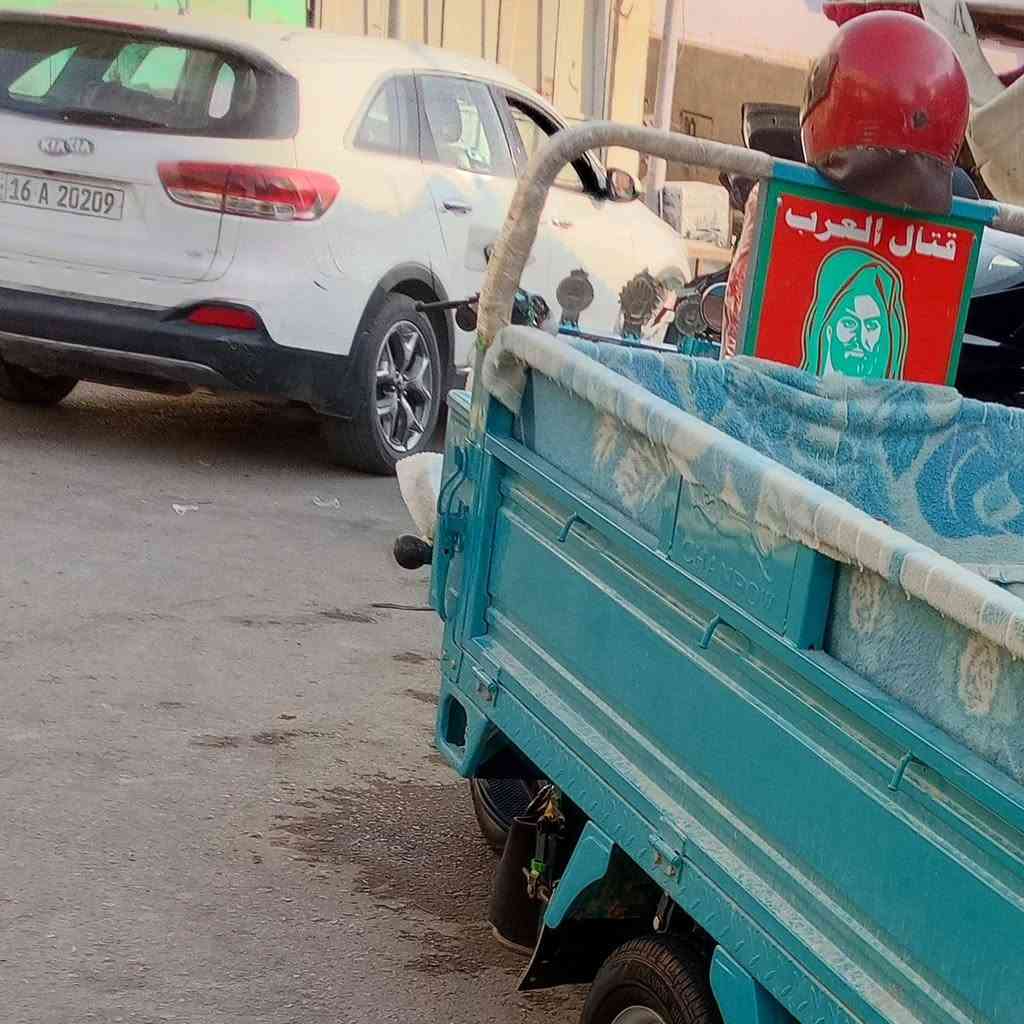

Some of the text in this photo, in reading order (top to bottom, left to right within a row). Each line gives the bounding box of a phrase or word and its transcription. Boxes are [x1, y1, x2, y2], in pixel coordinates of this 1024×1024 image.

[9, 177, 31, 202] 16
[38, 181, 49, 205] A
[56, 185, 115, 215] 20209
[784, 207, 957, 262] قتال العرب
